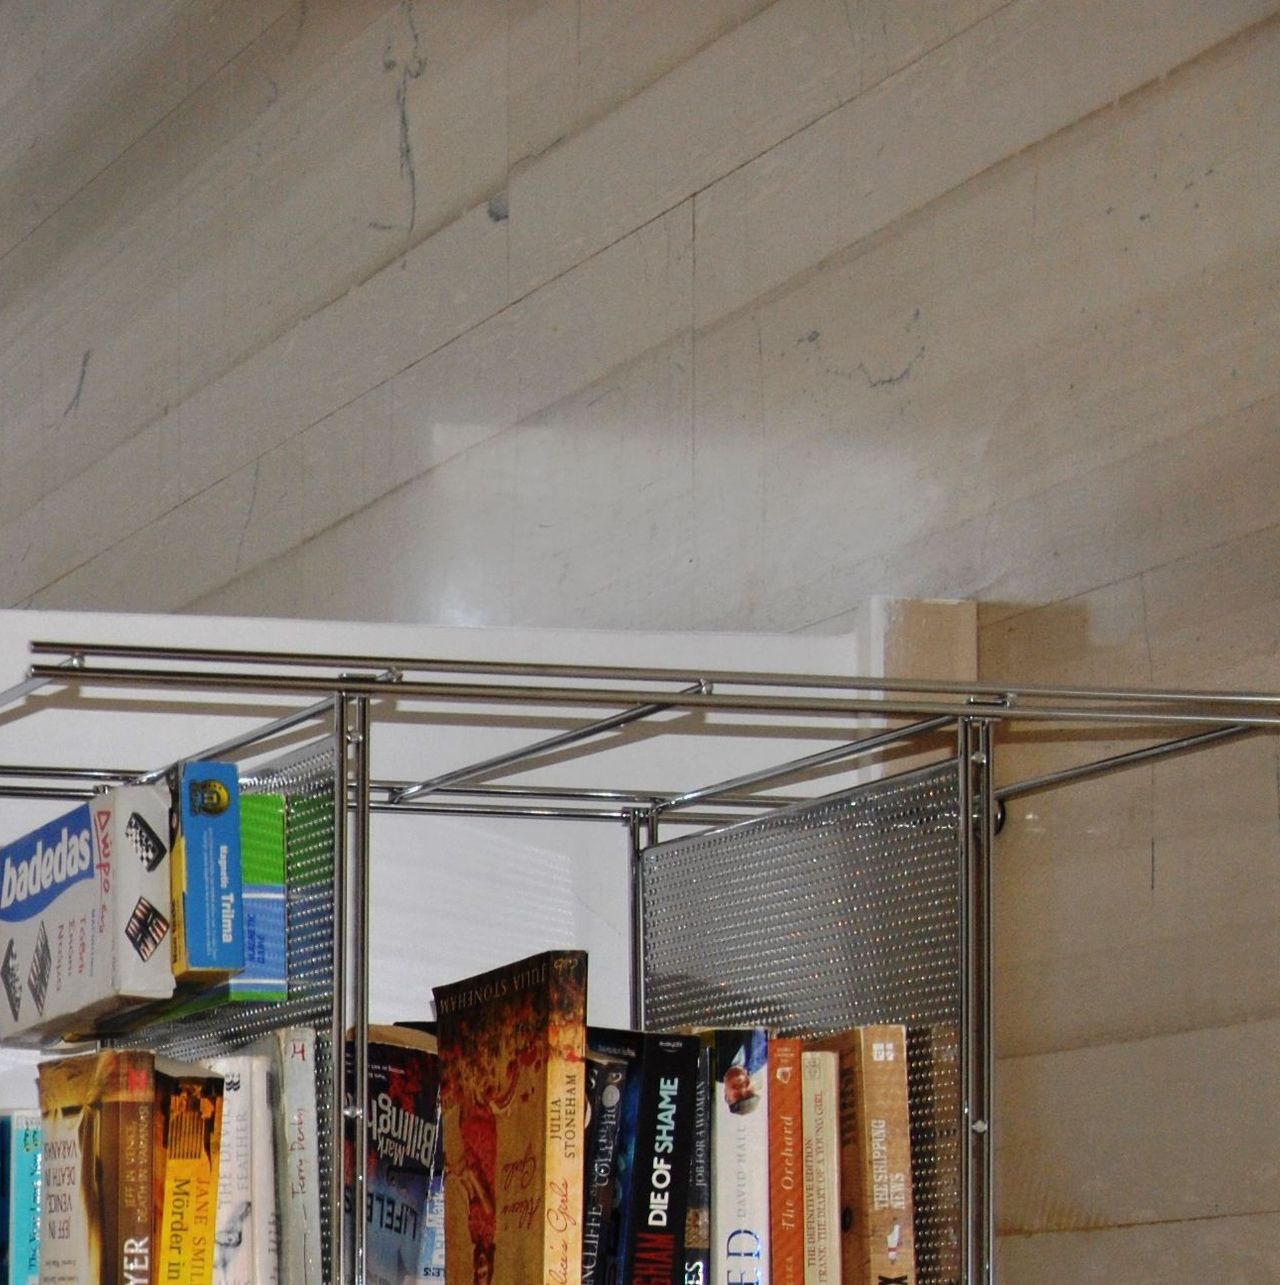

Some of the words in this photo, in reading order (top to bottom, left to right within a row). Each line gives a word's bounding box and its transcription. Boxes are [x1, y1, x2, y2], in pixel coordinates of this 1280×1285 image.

[0, 827, 91, 910] badedas
[549, 1098, 562, 1141] JULIA
[562, 1073, 578, 1160] STONEHAM
[654, 1077, 680, 1154] SHAME
[695, 1081, 707, 1129] WOMAN
[814, 1091, 824, 1116] GIRL
[695, 1140, 707, 1165] FOR
[735, 1124, 748, 1163] HALL
[778, 1115, 795, 1192] Orchard
[815, 1119, 826, 1155] YOUNG
[871, 1119, 887, 1183] SHIPPING
[650, 1156, 672, 1189] OF
[695, 1166, 707, 1188] JOB
[803, 1138, 814, 1181] EDITION
[817, 1168, 827, 1183] OF
[137, 1189, 149, 1223] DEATH
[193, 1176, 211, 1224] JANE
[546, 1178, 577, 1237] Girls
[647, 1191, 669, 1227] DIE
[735, 1168, 748, 1218] DAVID
[817, 1186, 828, 1217] DIARY
[873, 1184, 890, 1210] THE
[889, 1172, 906, 1210] NEWS
[170, 1176, 191, 1253] Mörder
[780, 1199, 795, 1230] The
[804, 1182, 815, 1243] DEFINITIVE
[818, 1220, 828, 1243] THE
[167, 1262, 188, 1280] in
[806, 1244, 816, 1268] THE
